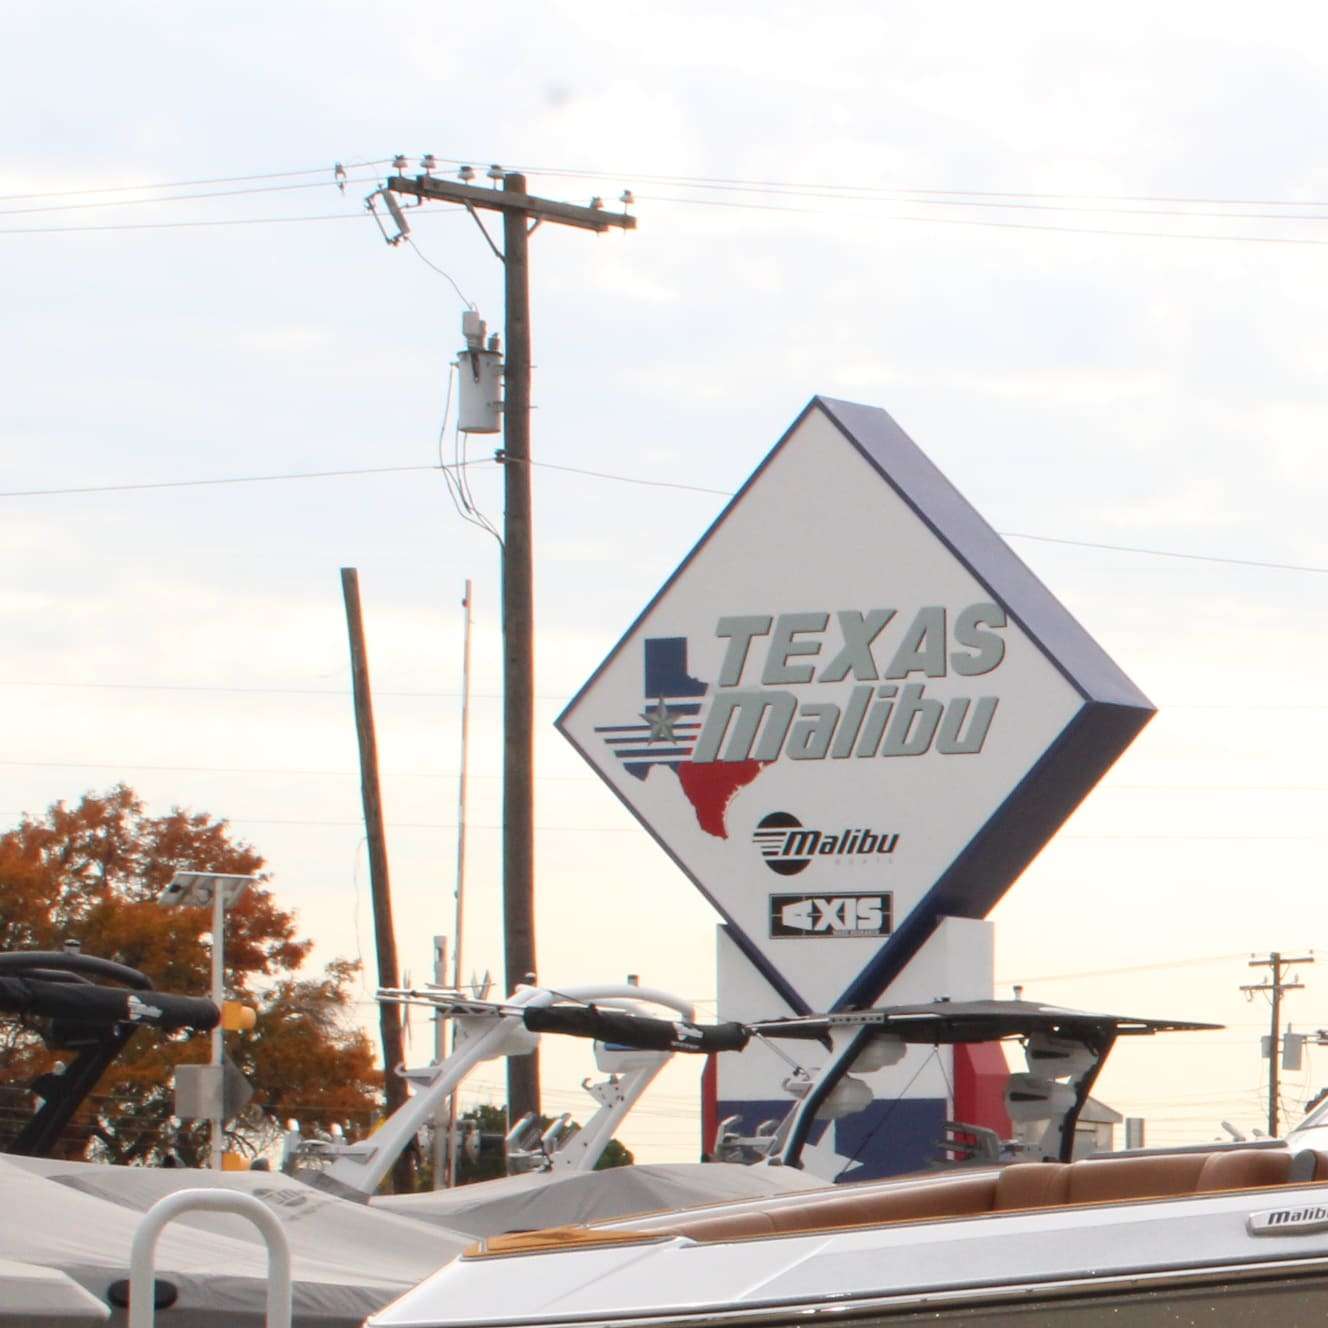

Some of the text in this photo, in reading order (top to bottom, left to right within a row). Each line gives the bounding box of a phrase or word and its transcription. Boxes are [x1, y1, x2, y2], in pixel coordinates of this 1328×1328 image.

[715, 602, 1007, 687] TEXAS
[692, 684, 999, 763] Malibu
[782, 829, 899, 856] Malibu
[782, 896, 883, 931] AXIS
